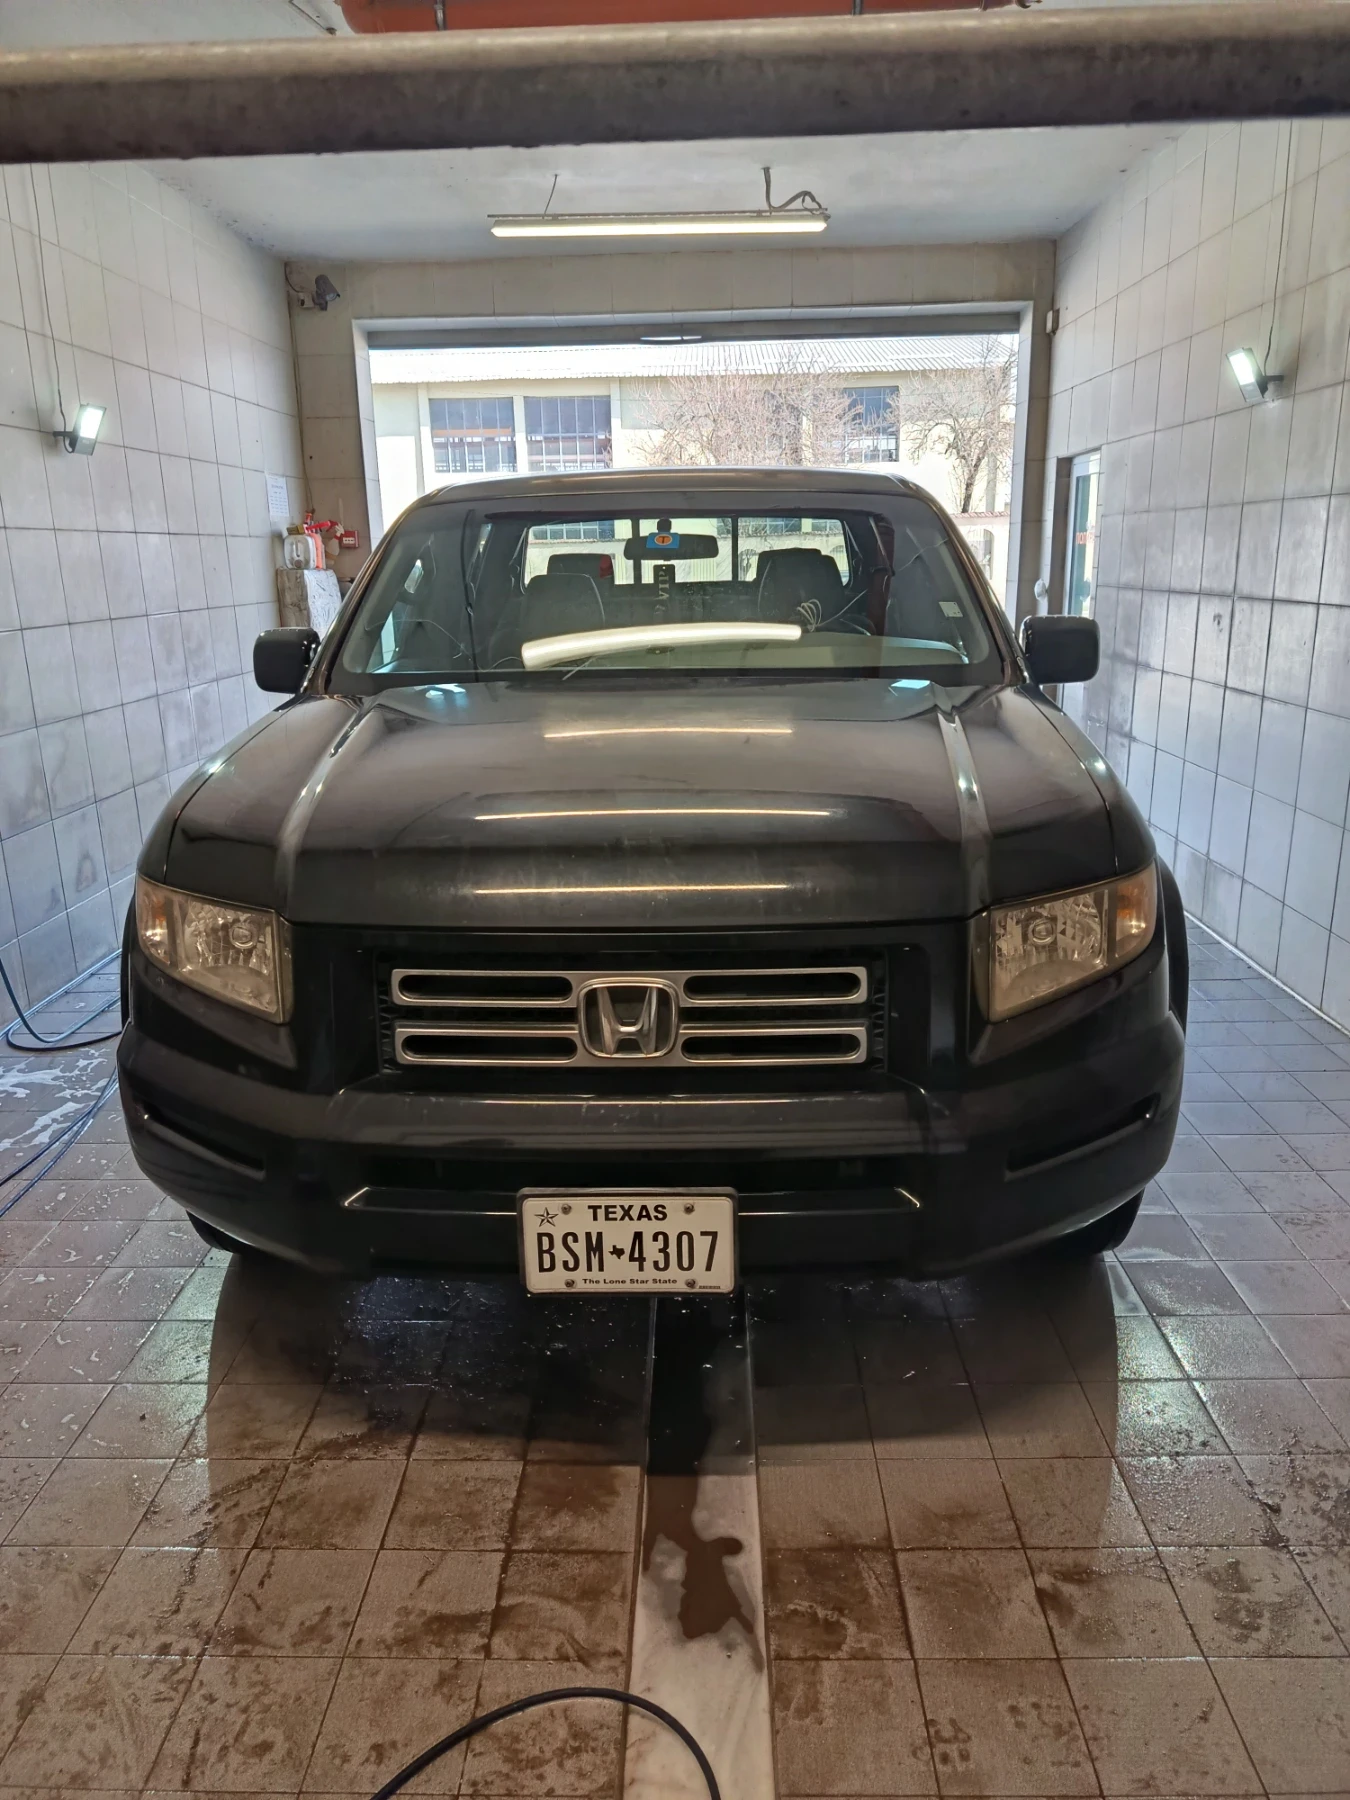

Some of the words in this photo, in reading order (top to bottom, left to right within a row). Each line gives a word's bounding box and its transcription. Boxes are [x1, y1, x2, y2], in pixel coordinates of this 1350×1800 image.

[587, 1204, 668, 1222] TEXAS
[536, 1231, 605, 1273] BSM
[628, 1230, 719, 1273] 4307
